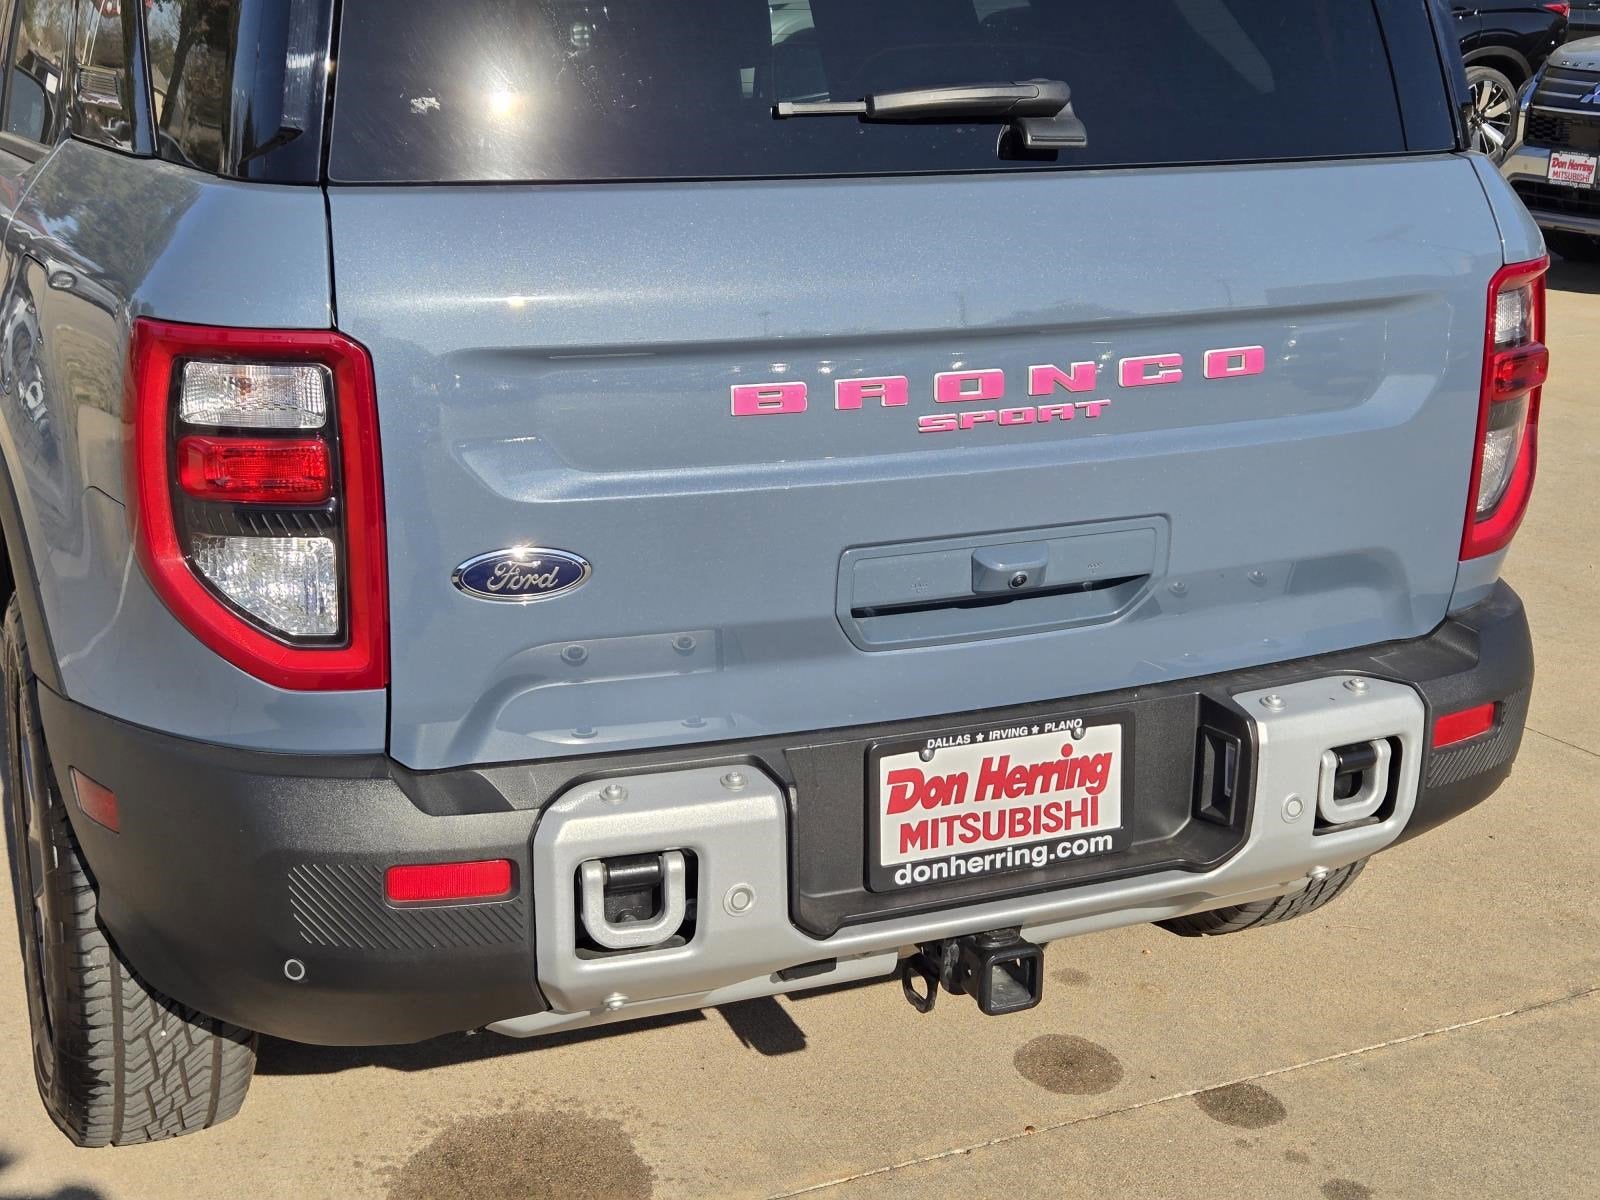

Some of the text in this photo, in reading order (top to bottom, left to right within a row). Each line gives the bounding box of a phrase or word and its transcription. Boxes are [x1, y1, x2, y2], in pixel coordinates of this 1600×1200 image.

[1551, 157, 1594, 175] Don Herring
[1552, 170, 1590, 182] MITSUBISHI
[730, 345, 1265, 416] BRONCO
[918, 399, 1111, 433] SPORT
[487, 560, 560, 591] Ford
[926, 718, 1083, 750] DALLAS IRVING PLANO
[886, 743, 1113, 815] Don Herring
[899, 795, 1099, 854] MITSUBISHI
[894, 834, 1113, 885] donherring.com
